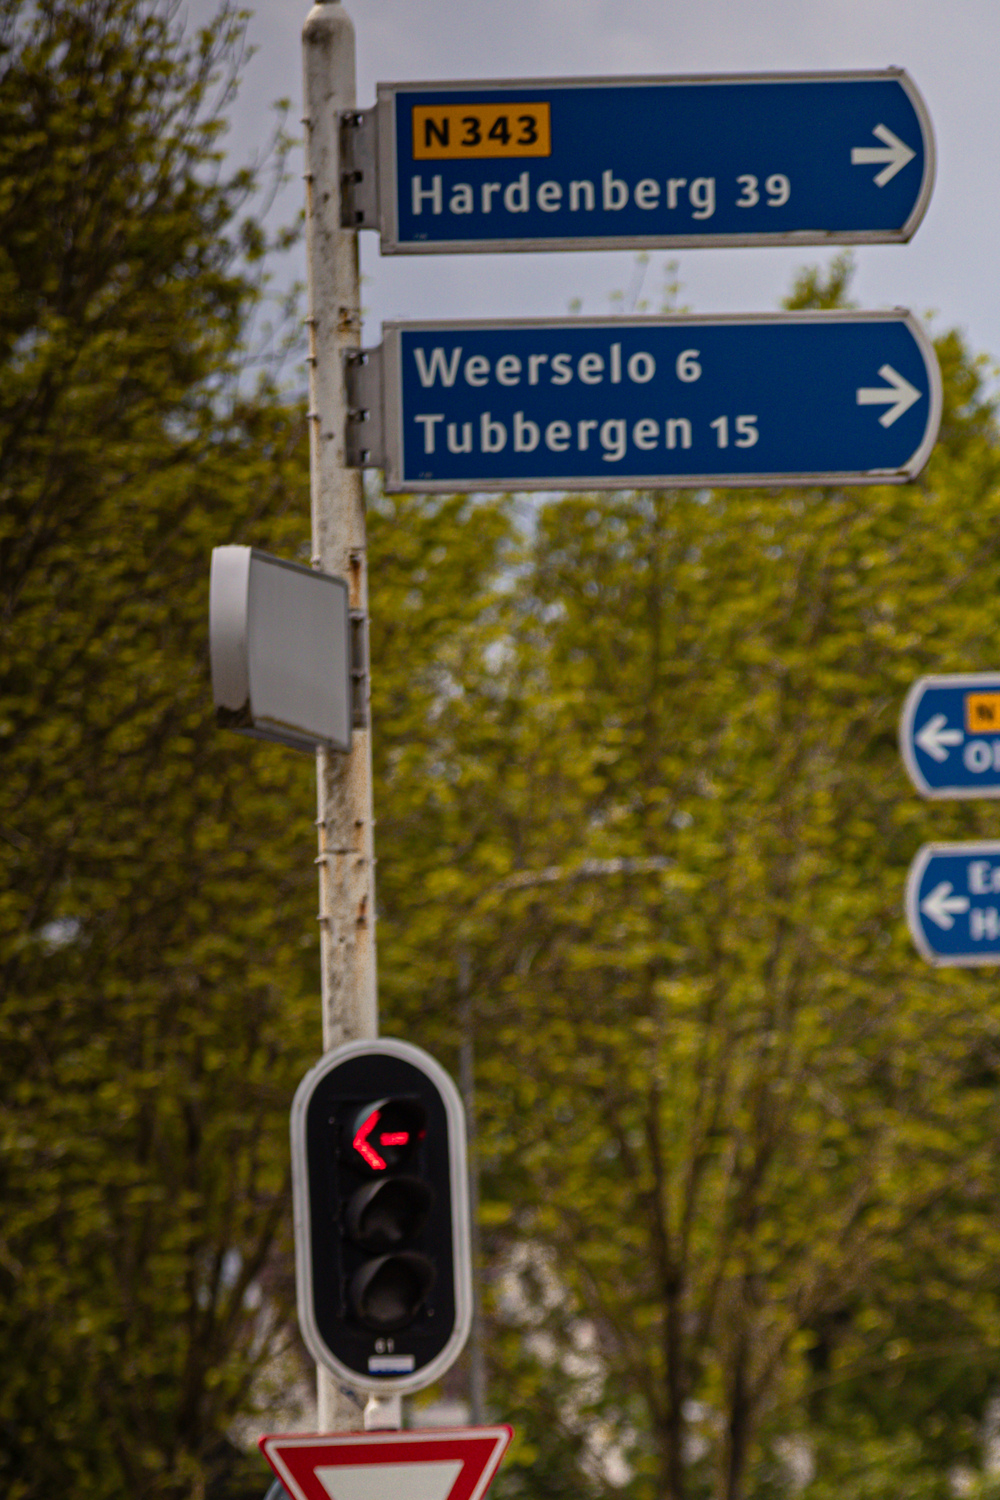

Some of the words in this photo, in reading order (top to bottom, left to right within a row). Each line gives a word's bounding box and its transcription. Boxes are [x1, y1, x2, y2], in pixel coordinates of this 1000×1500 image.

[412, 171, 716, 221] Hardenberg
[736, 174, 792, 209] 39
[414, 343, 657, 388] Weerselo
[676, 350, 703, 384] 6
[414, 412, 693, 463] Tubbergen
[710, 416, 760, 449] 15
